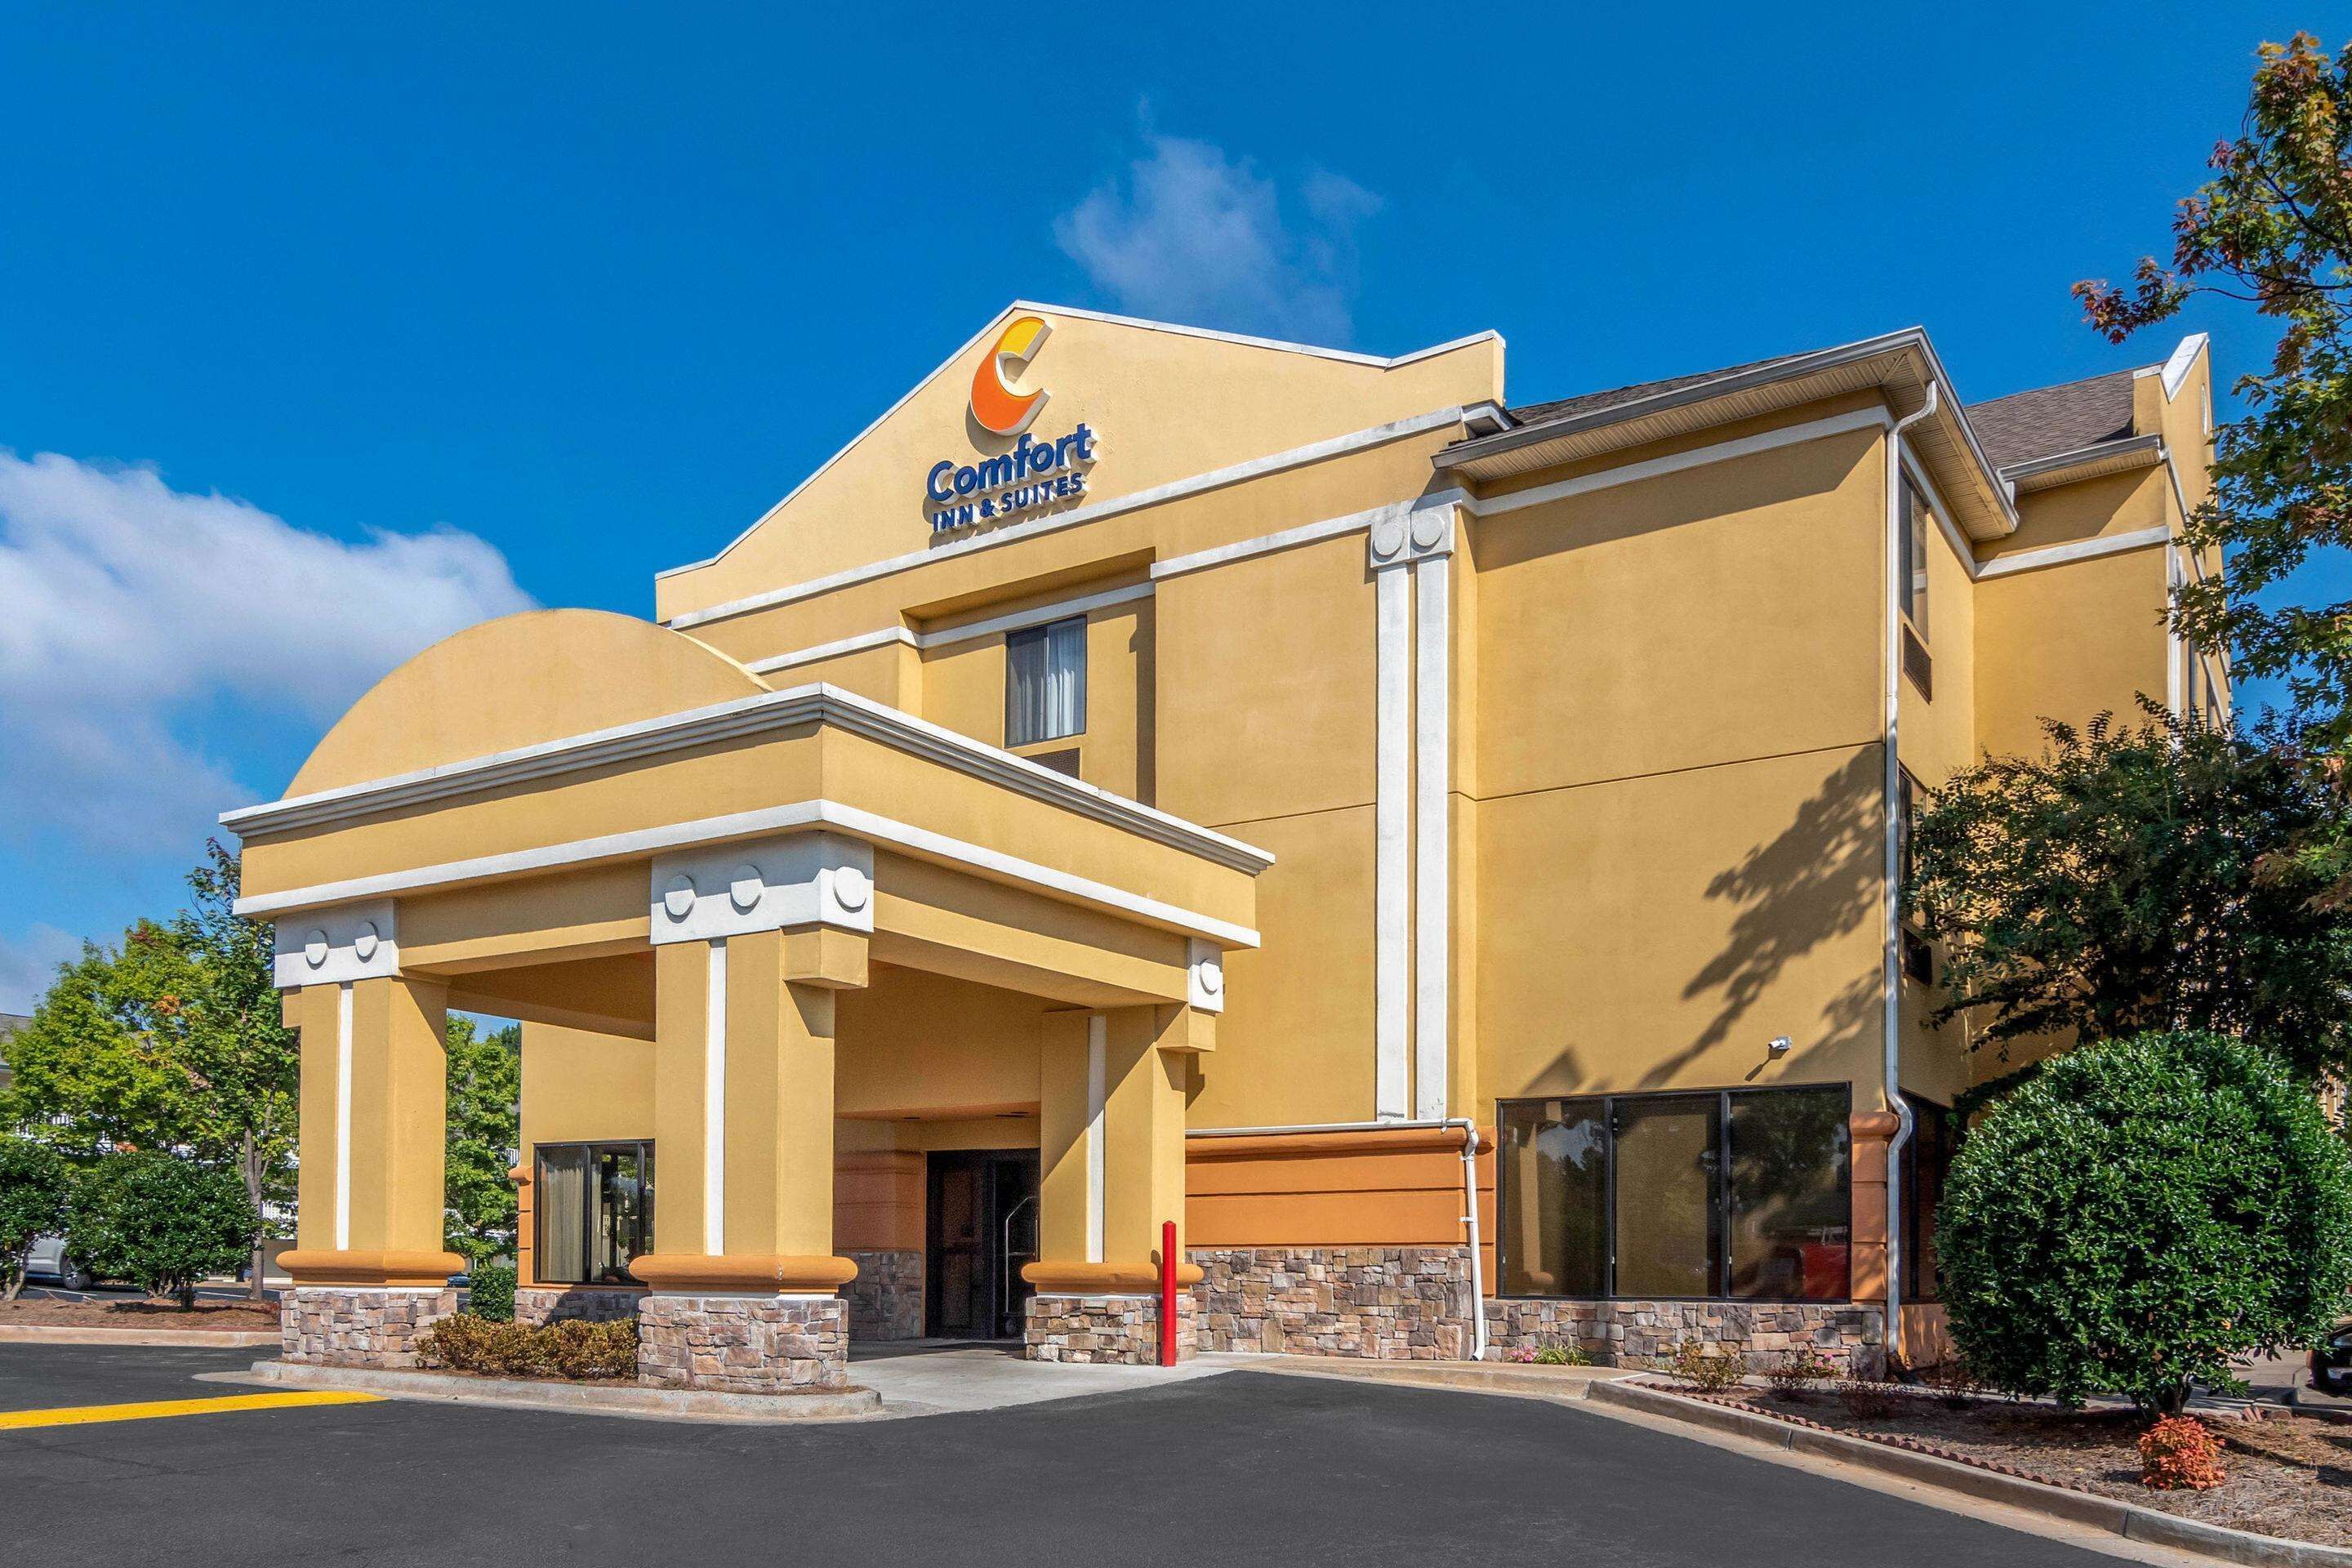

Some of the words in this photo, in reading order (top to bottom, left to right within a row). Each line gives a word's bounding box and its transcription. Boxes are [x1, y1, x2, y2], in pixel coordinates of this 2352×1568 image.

[927, 422, 1093, 502] Comfort
[933, 503, 973, 531] INN
[980, 497, 996, 518] &
[1001, 472, 1083, 511] SUITES
